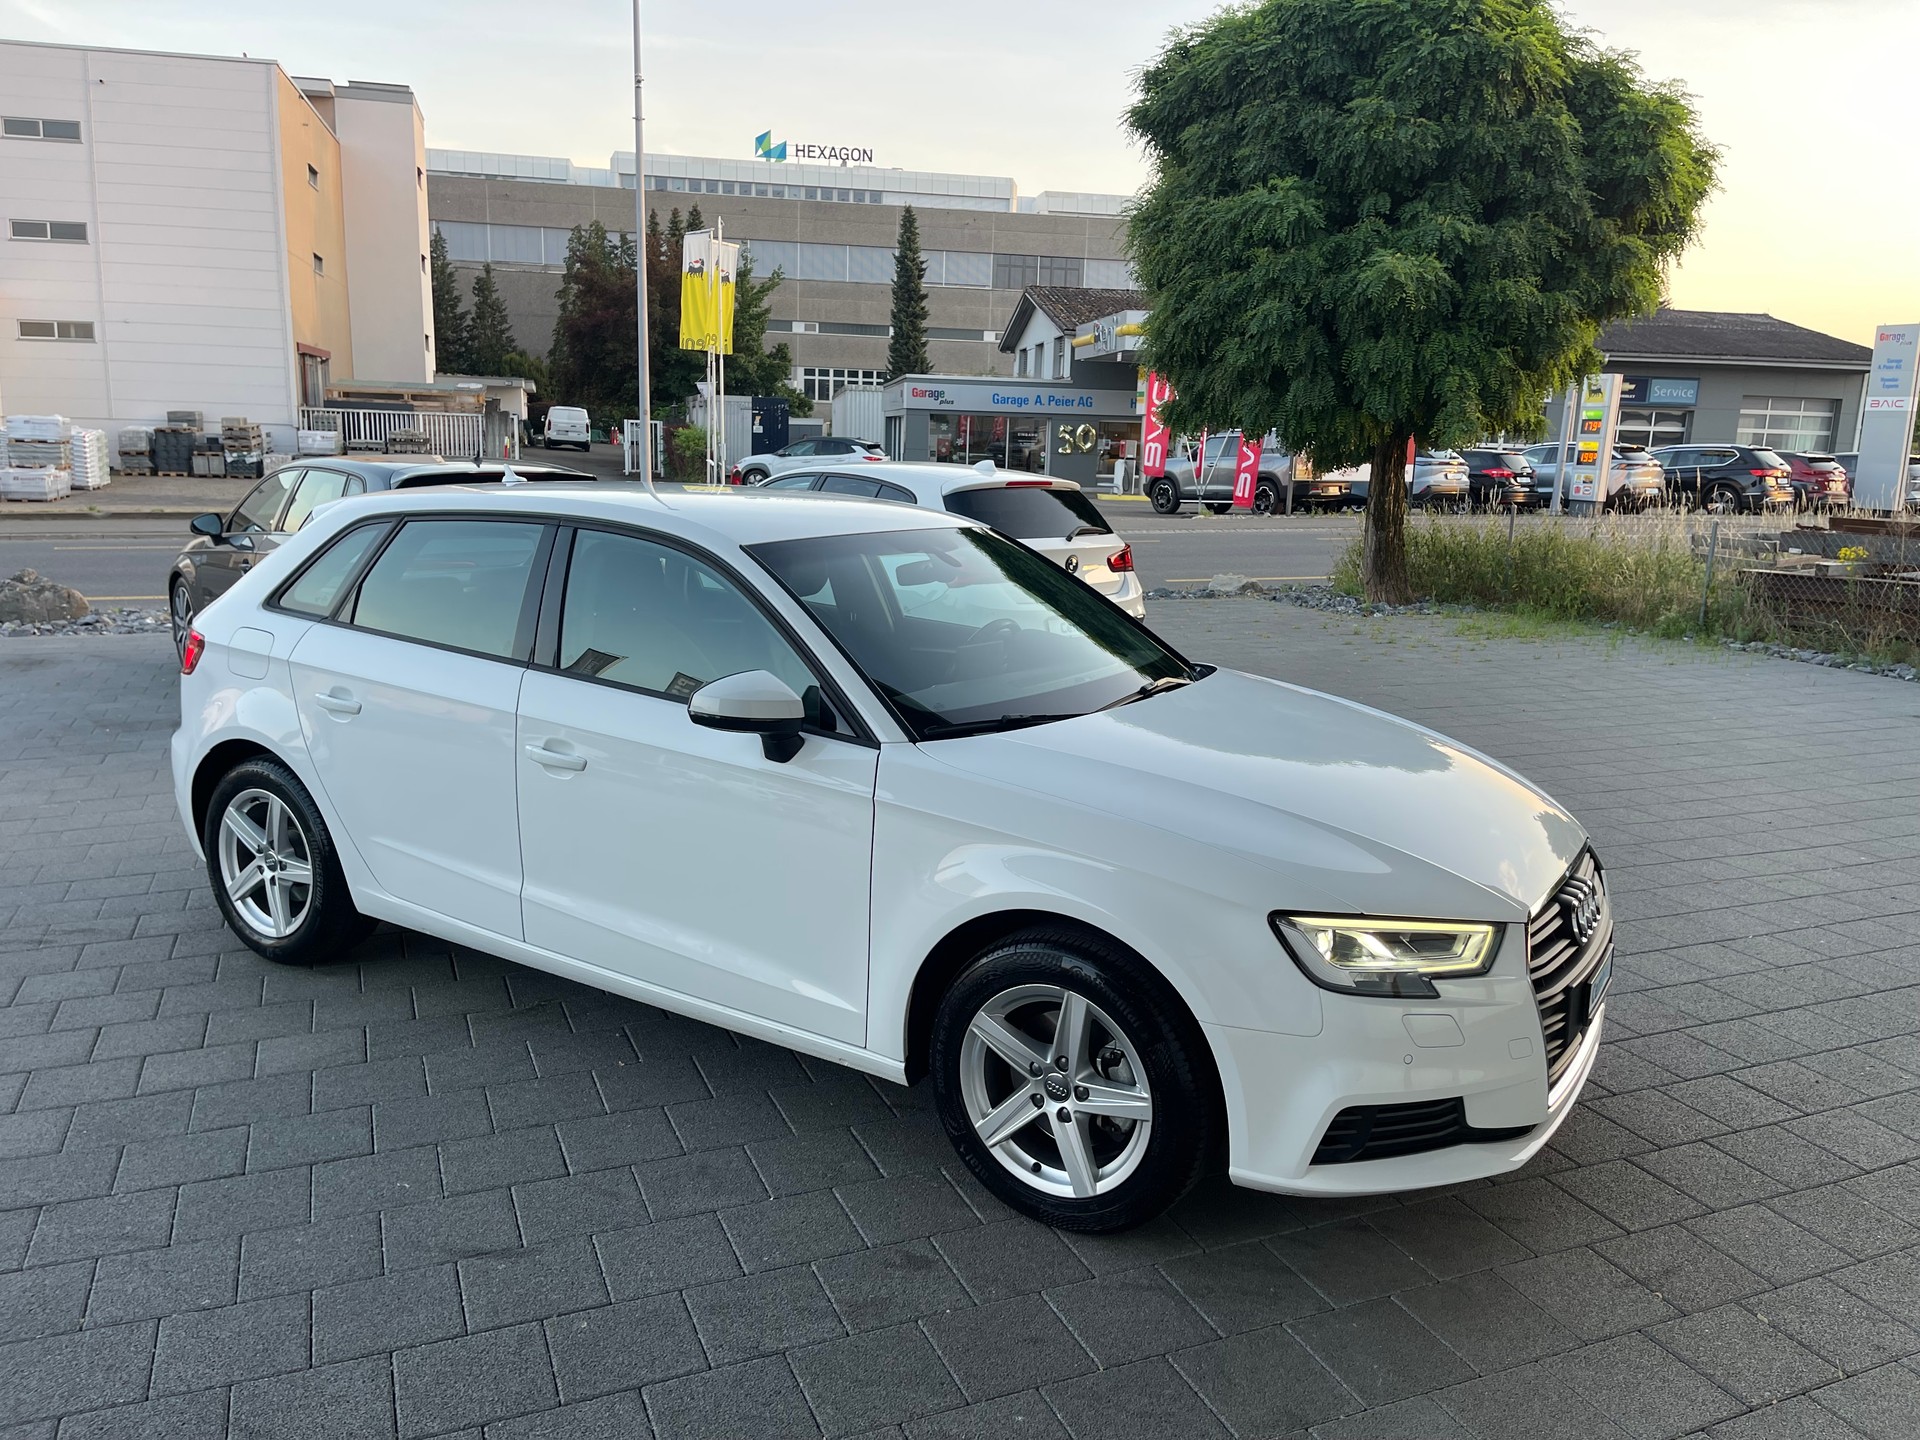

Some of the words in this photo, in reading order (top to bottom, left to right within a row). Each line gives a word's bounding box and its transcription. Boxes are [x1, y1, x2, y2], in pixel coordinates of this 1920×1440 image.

[795, 143, 873, 162] HEXAGON
[911, 387, 946, 401] Garage
[1653, 386, 1694, 398] Service
[991, 393, 1030, 408] Garage
[1034, 394, 1046, 406] A.
[1047, 395, 1076, 407] Peier
[1077, 396, 1093, 408] AG
[1870, 400, 1905, 408] BAIC
[1057, 422, 1098, 455] 50
